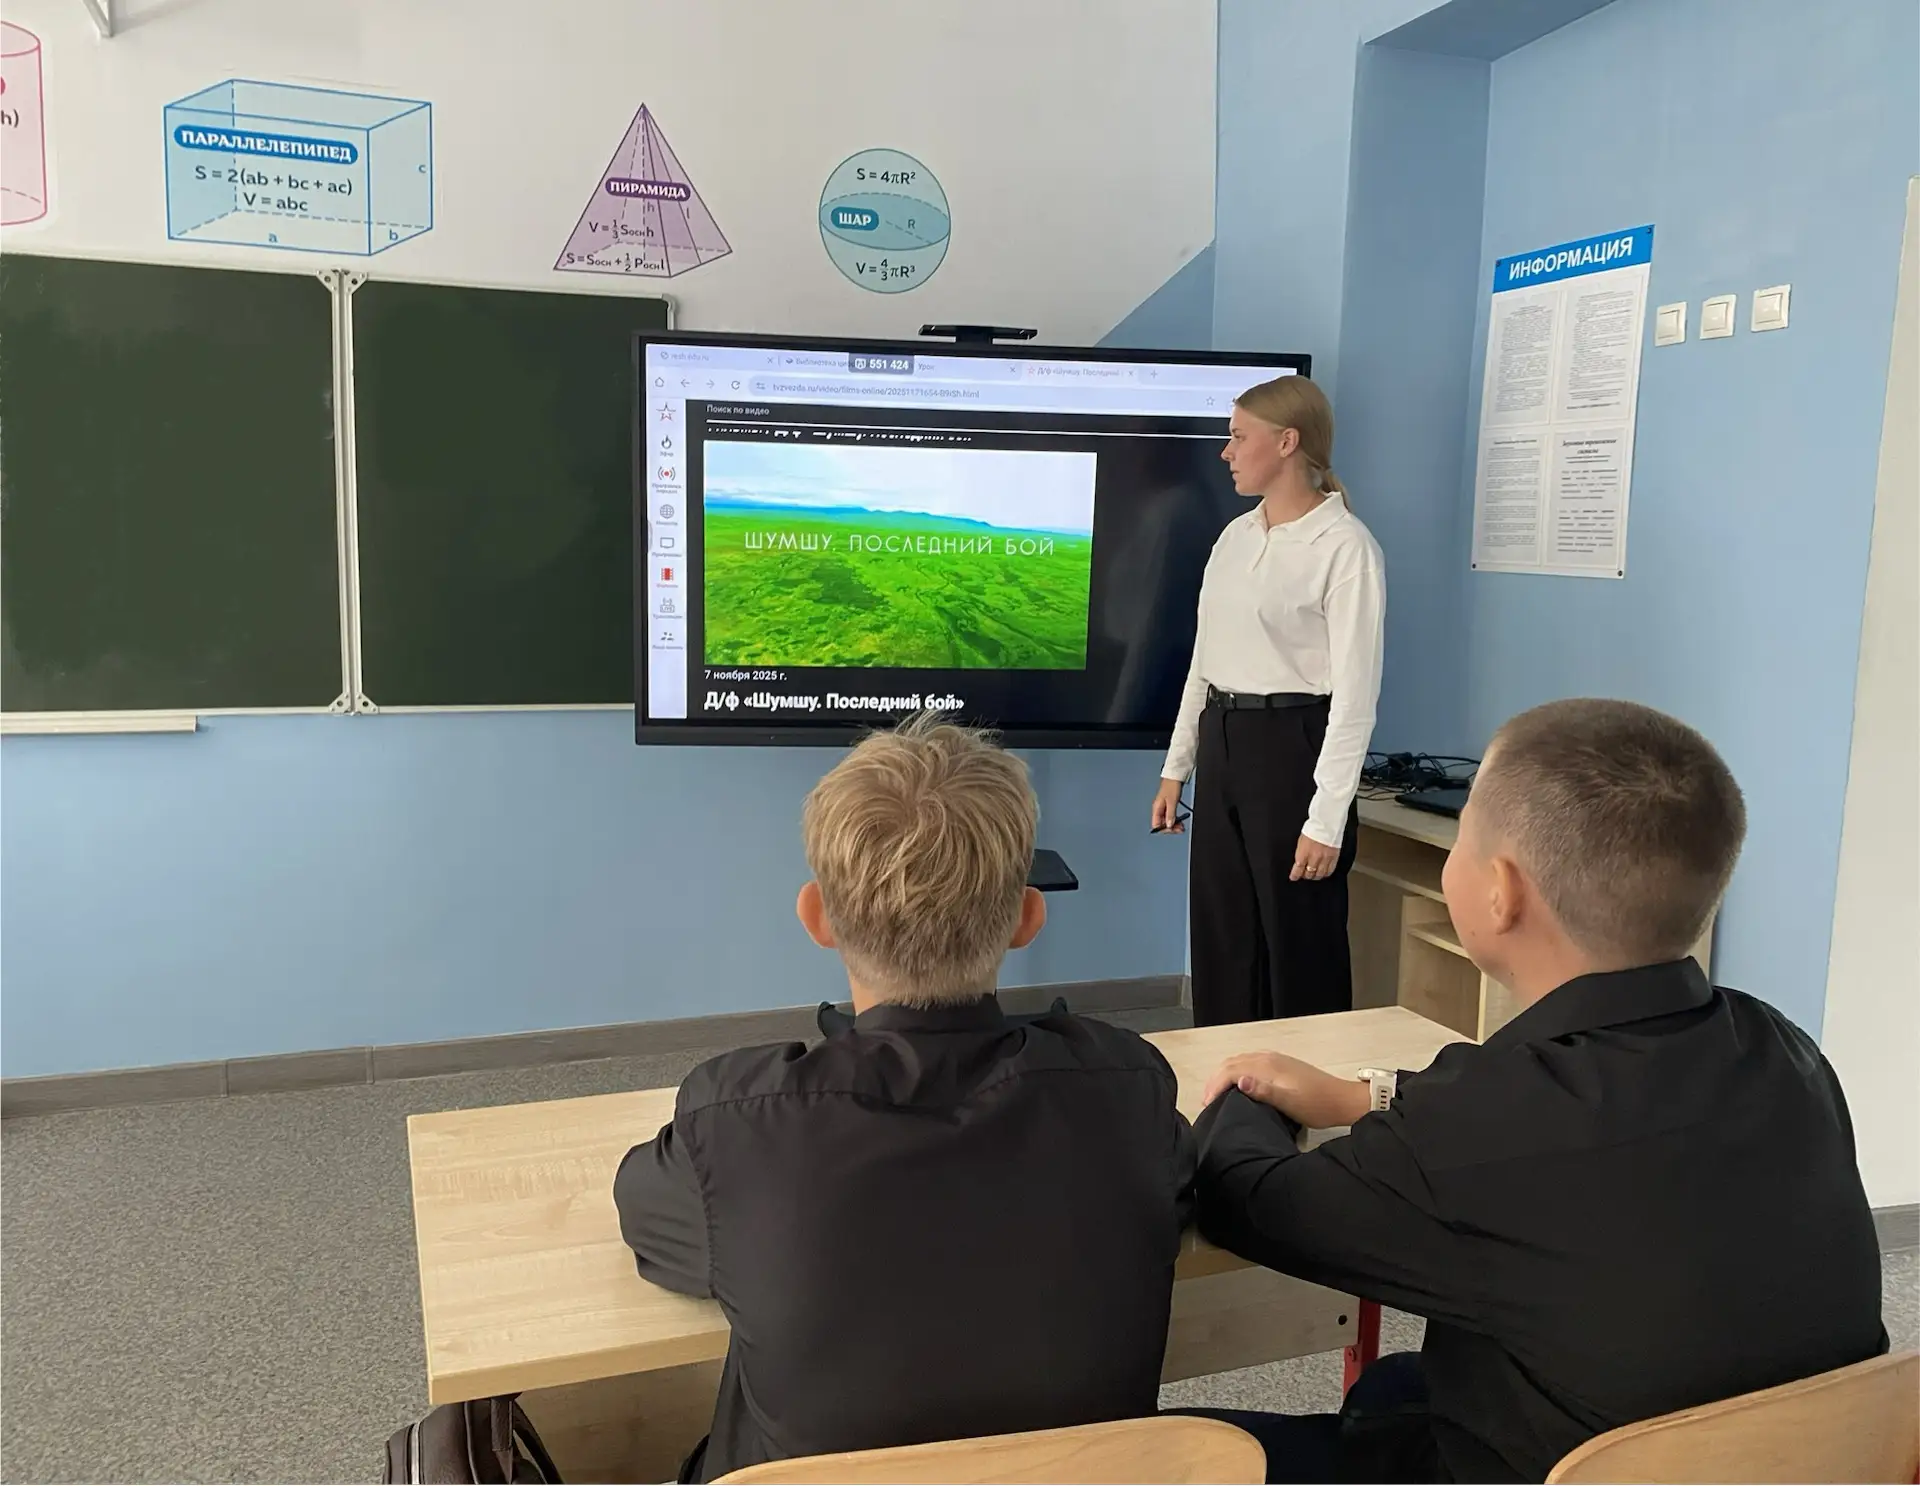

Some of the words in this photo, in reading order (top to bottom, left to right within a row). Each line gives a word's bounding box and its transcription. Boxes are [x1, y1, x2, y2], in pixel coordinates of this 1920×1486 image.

[181, 130, 352, 162] ПАРАЛЛЕЛЕПИПЕД
[610, 181, 686, 199] ПИРАМИДА
[838, 212, 872, 226] ШАР
[908, 219, 916, 229] R
[389, 228, 399, 241] b
[1508, 236, 1634, 281] ИНФОРМАЦИЯ
[869, 358, 887, 369] 551
[890, 359, 909, 371] 424
[706, 404, 731, 414] Поиск
[745, 407, 770, 416] видео
[850, 534, 992, 555] ПОСЛЕДНИЙ
[1005, 536, 1054, 556] БОЙ
[704, 670, 711, 680] 7
[713, 670, 750, 682] ноября
[753, 671, 777, 681] 2025
[780, 673, 787, 681] г.
[704, 691, 739, 711] Д/ф
[744, 692, 821, 712] «Шумшу.
[826, 693, 920, 712] Последний
[924, 693, 965, 711] бой»
